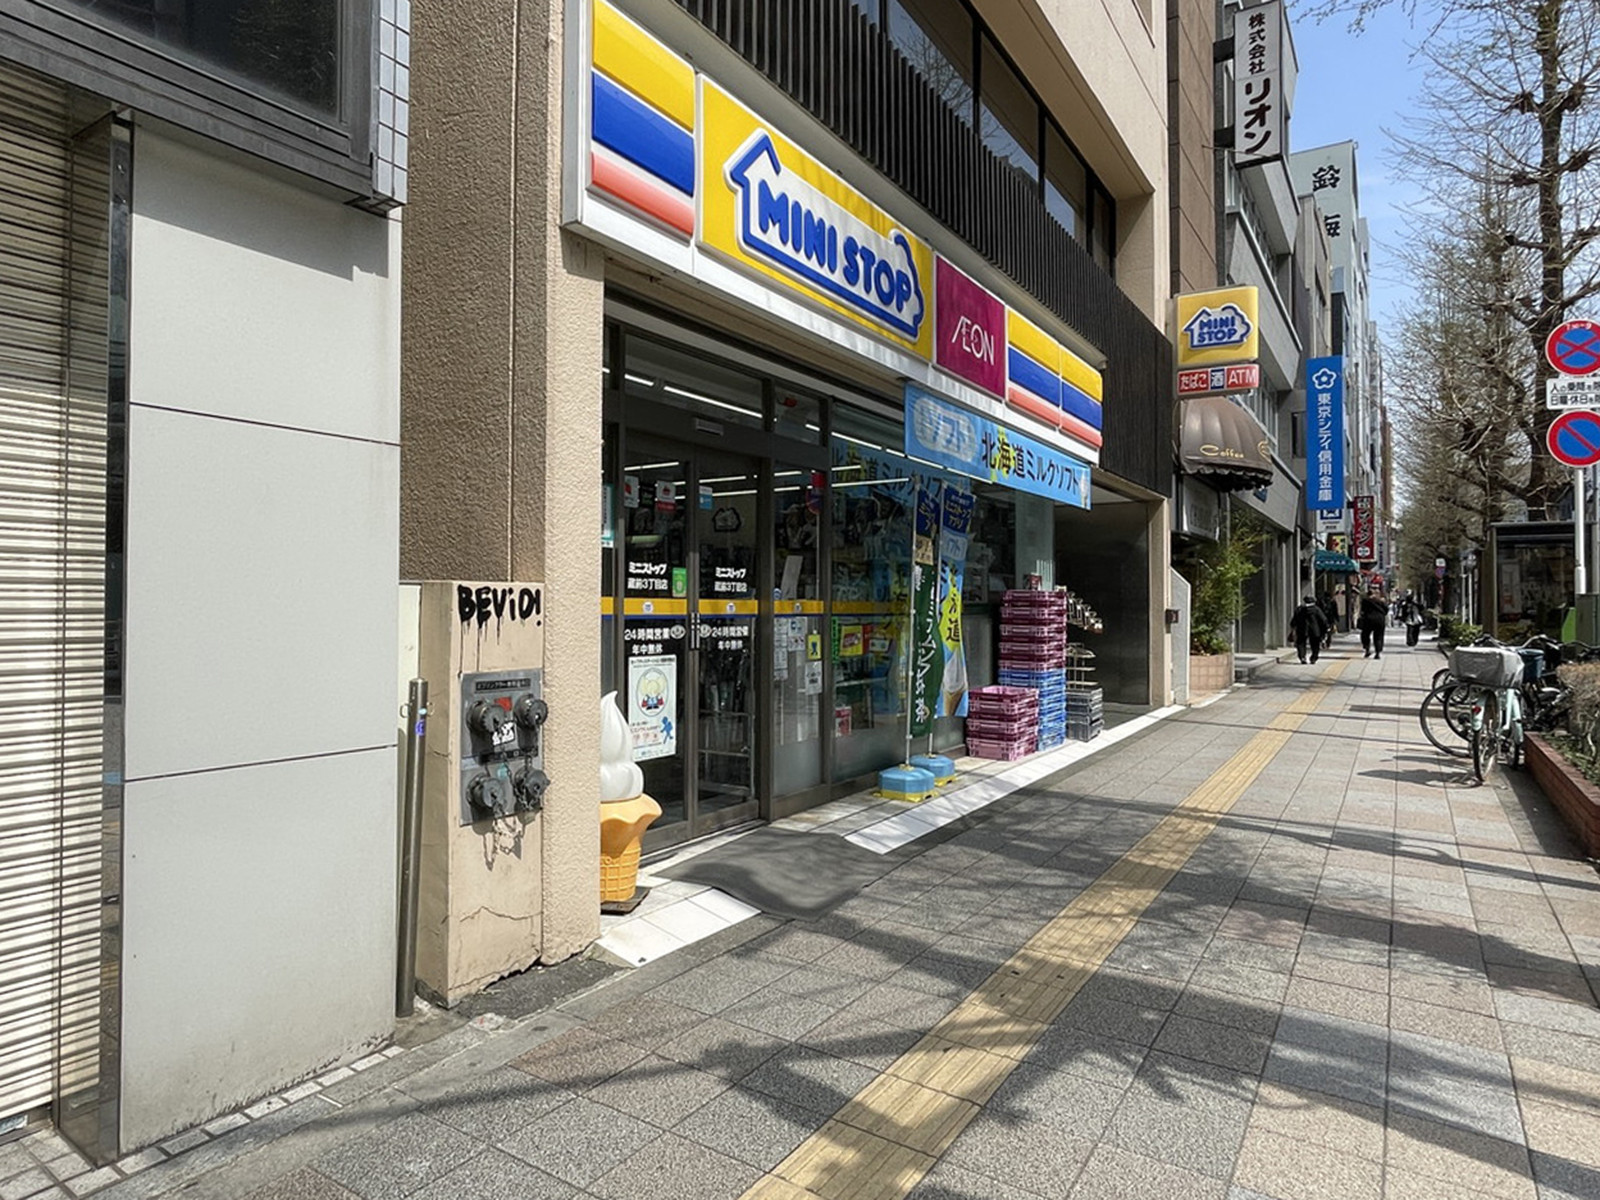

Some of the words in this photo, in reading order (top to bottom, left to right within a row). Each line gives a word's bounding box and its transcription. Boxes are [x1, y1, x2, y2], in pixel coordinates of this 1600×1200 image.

[1244, 12, 1271, 154] 株式会社リオン
[758, 178, 837, 275] MINI
[842, 235, 912, 313] STOP
[1199, 316, 1236, 331] MINI
[1197, 328, 1238, 343] STOP
[1179, 373, 1208, 390] たばこ
[1211, 370, 1225, 386] 酒
[1228, 368, 1257, 385] ATM
[1317, 392, 1334, 502] 東京シティ信用金庫
[981, 430, 1080, 496] 北海道ミルクソフト
[628, 561, 668, 575] ミニストップ
[715, 566, 747, 579] ミニストップ
[624, 627, 670, 641] 24時間営業
[711, 625, 749, 638] 24時間営業
[632, 643, 663, 655] 年中無休
[717, 640, 744, 651] 年中無休
